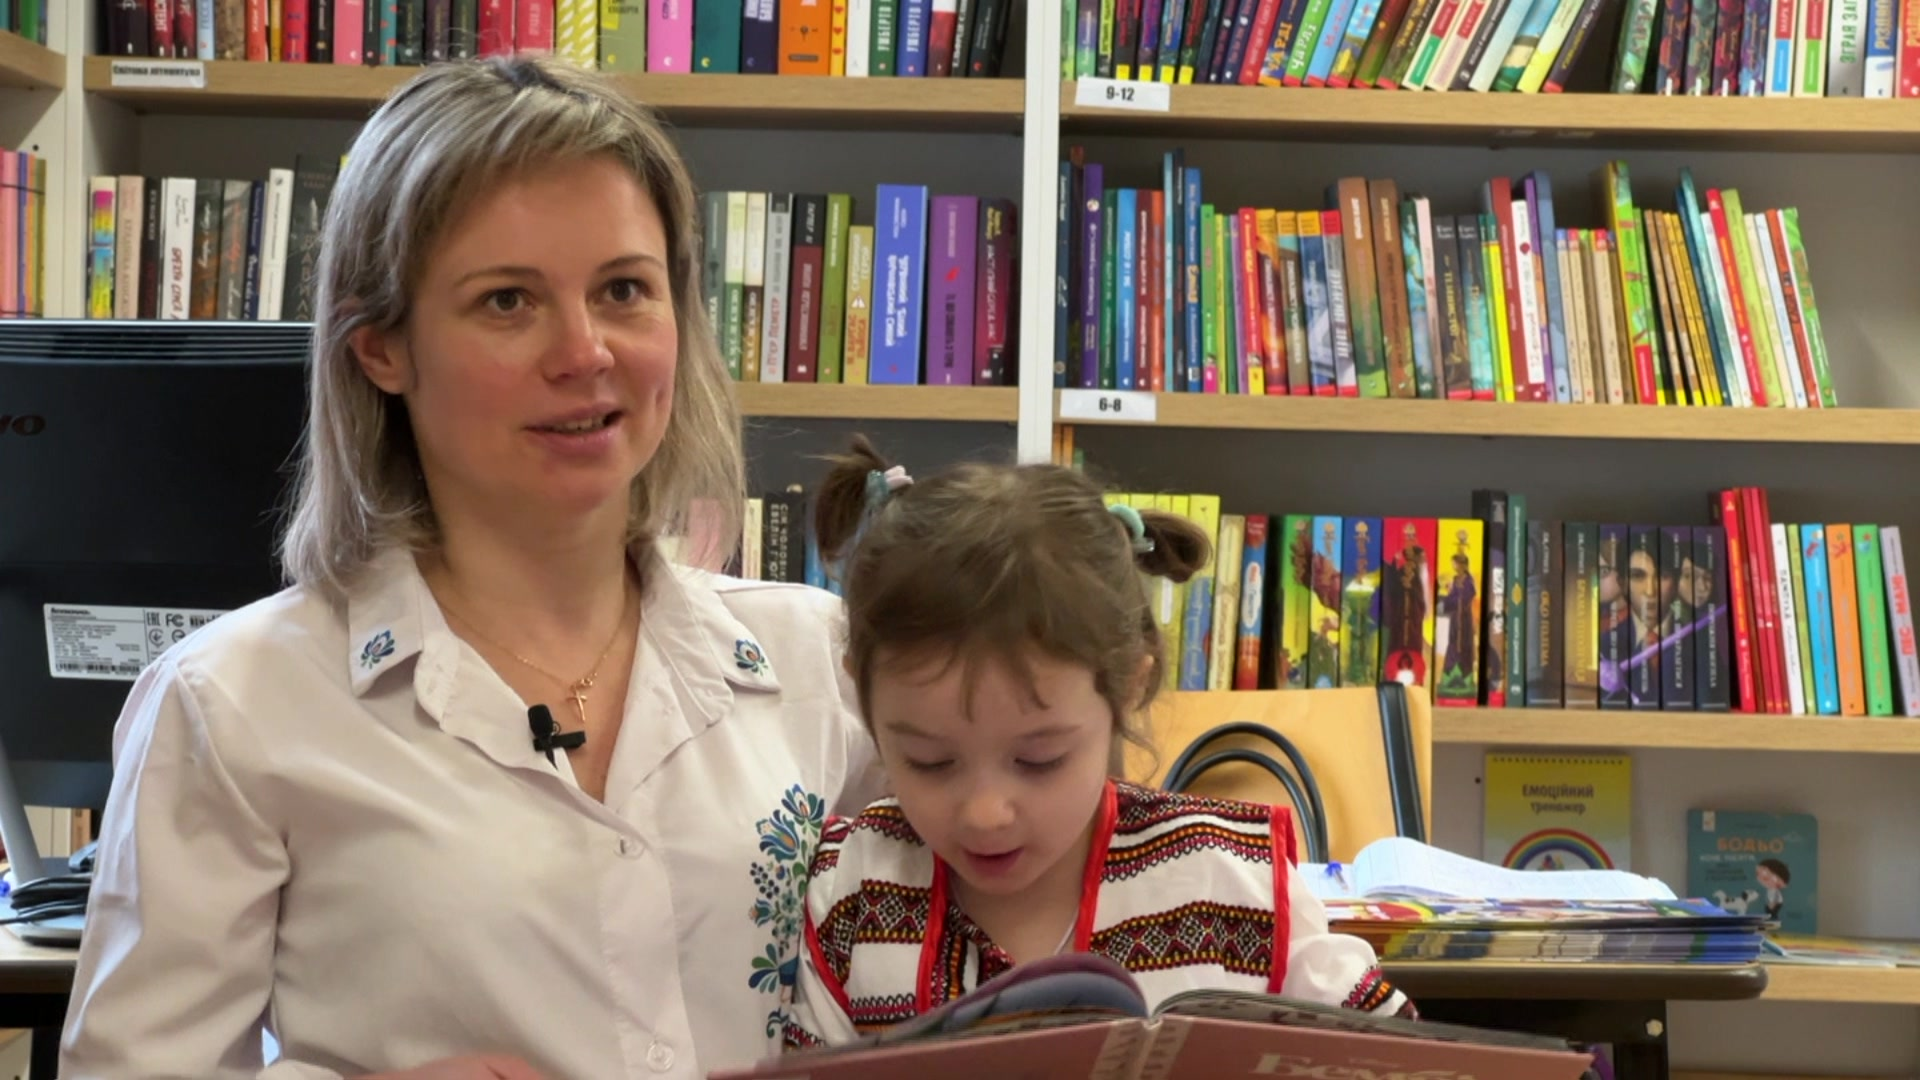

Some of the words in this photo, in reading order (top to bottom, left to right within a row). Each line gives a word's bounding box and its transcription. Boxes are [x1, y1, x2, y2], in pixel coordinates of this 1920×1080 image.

[1105, 86, 1135, 102] 9-12
[1098, 397, 1122, 412] 6-8
[1891, 574, 1908, 615] МАНІ
[1899, 625, 1915, 656] ПЕС
[1522, 784, 1594, 799] ЕМОЦІЙНИЙ
[1530, 803, 1586, 816] тренажер
[1717, 837, 1784, 853] БОДЬО
